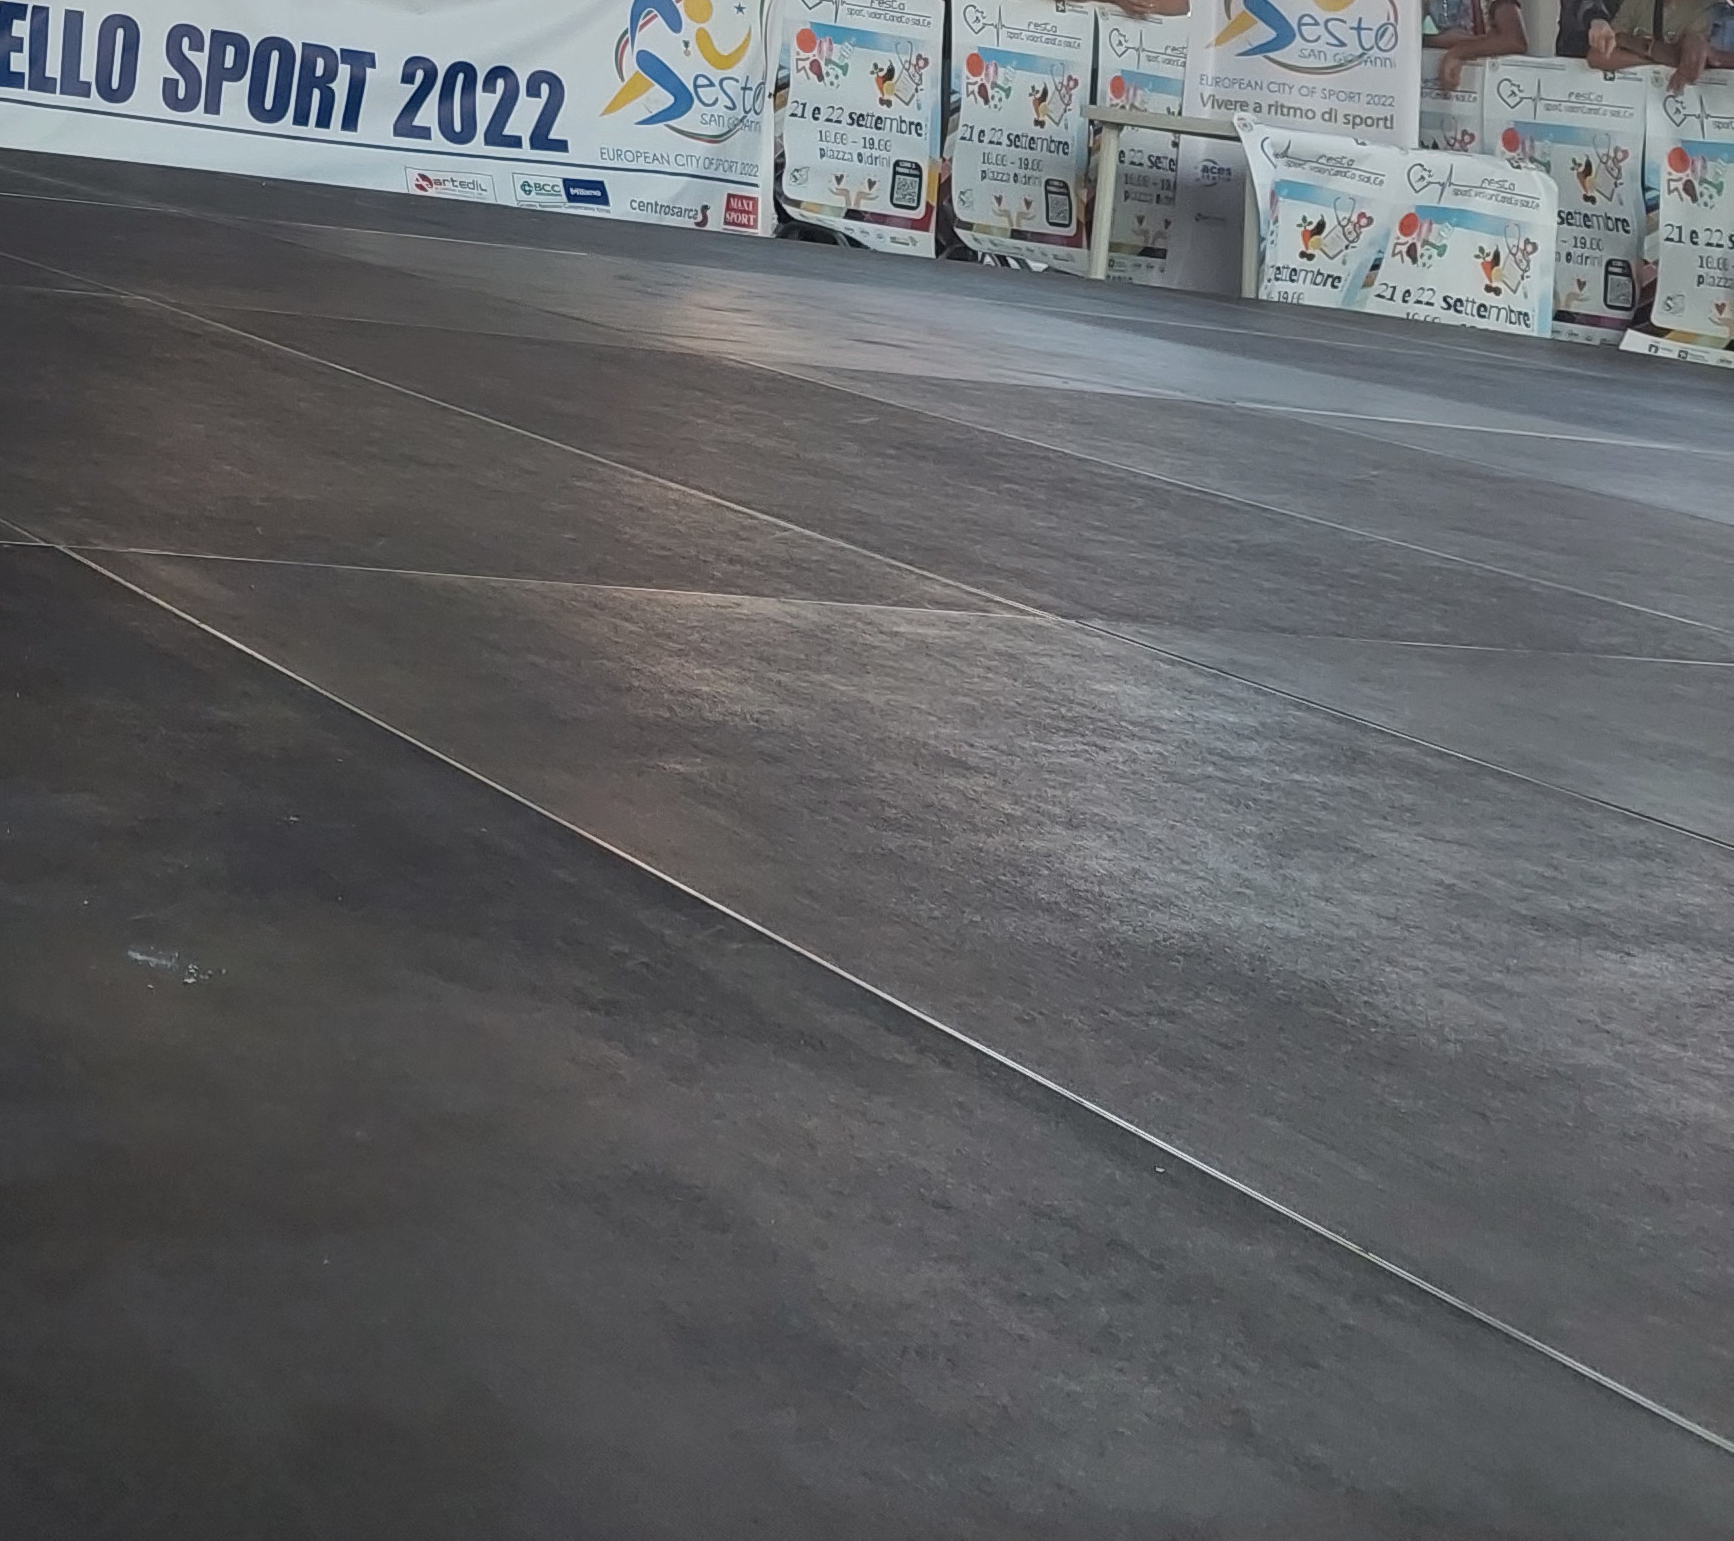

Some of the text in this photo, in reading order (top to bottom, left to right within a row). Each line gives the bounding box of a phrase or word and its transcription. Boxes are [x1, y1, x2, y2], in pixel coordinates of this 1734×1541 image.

[162, 22, 376, 133] SPORT
[392, 55, 569, 154] 2022
[1199, 74, 1394, 107] EUROPEAN CITY OF SPORT 2022
[789, 100, 923, 138] 21 e 22 settembre
[1200, 92, 1249, 112] Vivere
[1253, 101, 1262, 113] a
[1268, 101, 1315, 120] ritmo
[1321, 107, 1338, 123] di
[959, 124, 1070, 156] 21 e 22 settembre
[600, 147, 759, 178] EUROPEAN CITY OF SPORT 2022
[818, 146, 854, 162] piazza
[1118, 149, 1126, 164] e
[1200, 163, 1231, 177] aces
[534, 182, 561, 193] BCC
[629, 199, 699, 220] centrosarca
[730, 197, 753, 211] MAXI
[726, 212, 756, 226] SPORT
[1557, 209, 1630, 235] settembre
[1664, 223, 1685, 244] 21
[1690, 229, 1699, 245] e
[1704, 227, 1724, 248] 22
[1696, 273, 1734, 289] piazz
[1374, 283, 1397, 302] 21
[1402, 287, 1411, 304] e
[1415, 287, 1435, 307] 22
[1441, 292, 1532, 329] settembre
